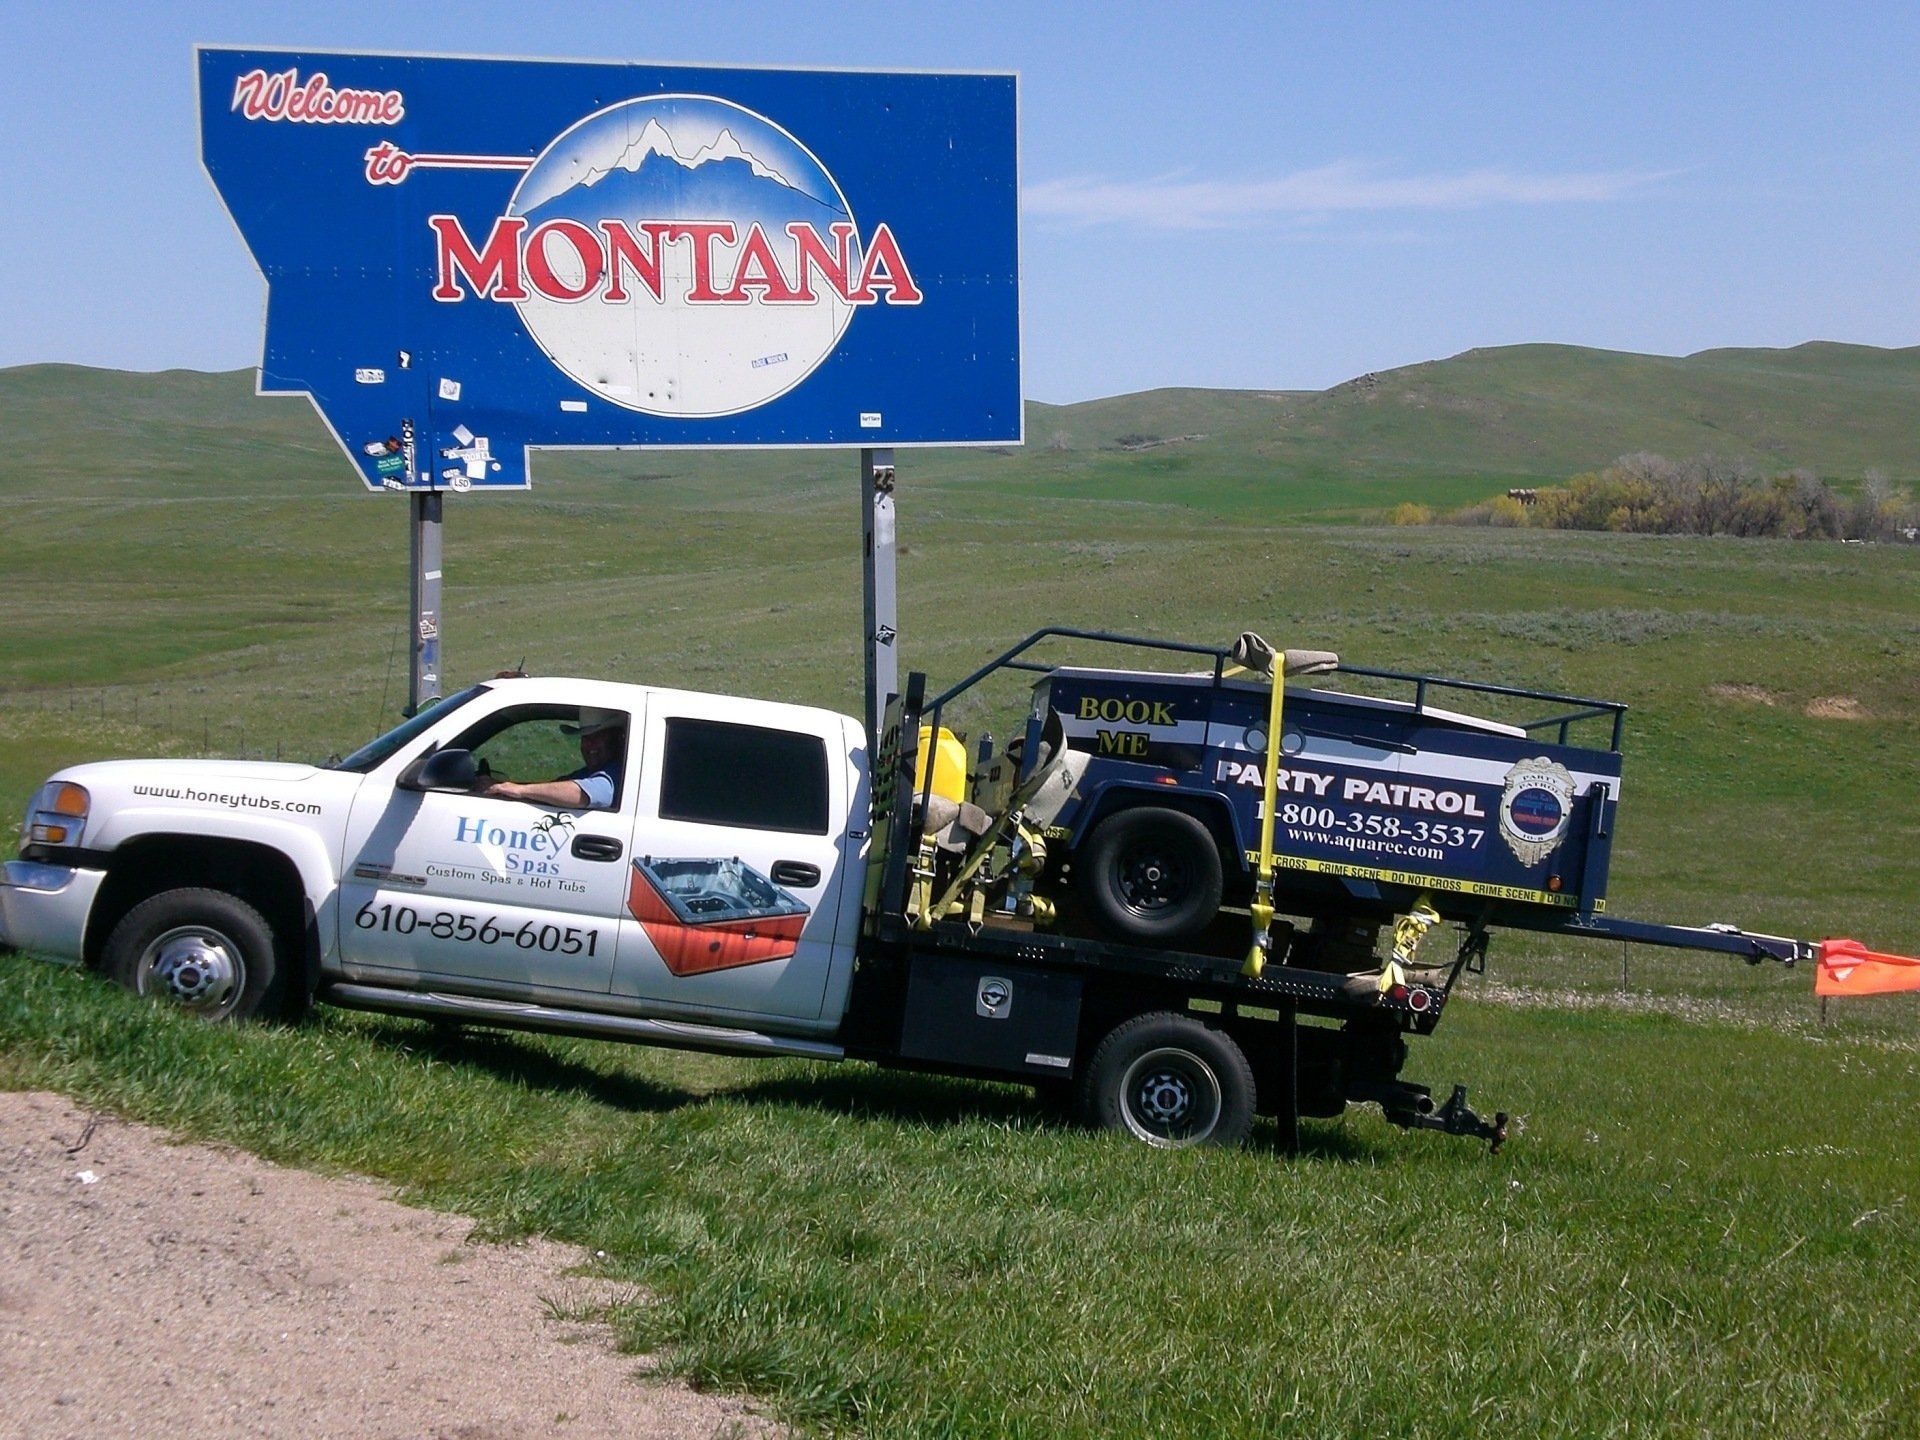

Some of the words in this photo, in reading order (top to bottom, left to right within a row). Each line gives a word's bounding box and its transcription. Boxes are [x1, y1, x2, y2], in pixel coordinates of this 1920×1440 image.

[231, 68, 405, 125] Welcome
[364, 141, 411, 185] to
[428, 215, 923, 305] MONTANA
[1076, 697, 1177, 726] BOOK
[1098, 730, 1150, 757] ME
[133, 785, 322, 815] www.honeytubs.com
[1216, 760, 1335, 796] PARTY
[1343, 778, 1485, 817] PATROL
[454, 816, 571, 861] Honey
[1254, 800, 1485, 849] 1-800-358-3537
[1288, 828, 1444, 861] www.aquarec.com
[426, 865, 475, 880] Custom
[482, 871, 511, 885] Spas
[530, 877, 551, 888] Hot
[558, 881, 586, 893] Tubs
[505, 853, 560, 876] Spas
[1276, 857, 1307, 869] CROSS
[1318, 862, 1349, 875] CRIME
[1351, 866, 1381, 880] SCENE
[1392, 872, 1405, 882] DO
[1407, 875, 1427, 886] NOT
[1429, 878, 1461, 891] CROSS
[1472, 883, 1503, 896] CRIME
[1505, 888, 1536, 901] SCENE
[354, 901, 599, 957] 610-856-6051
